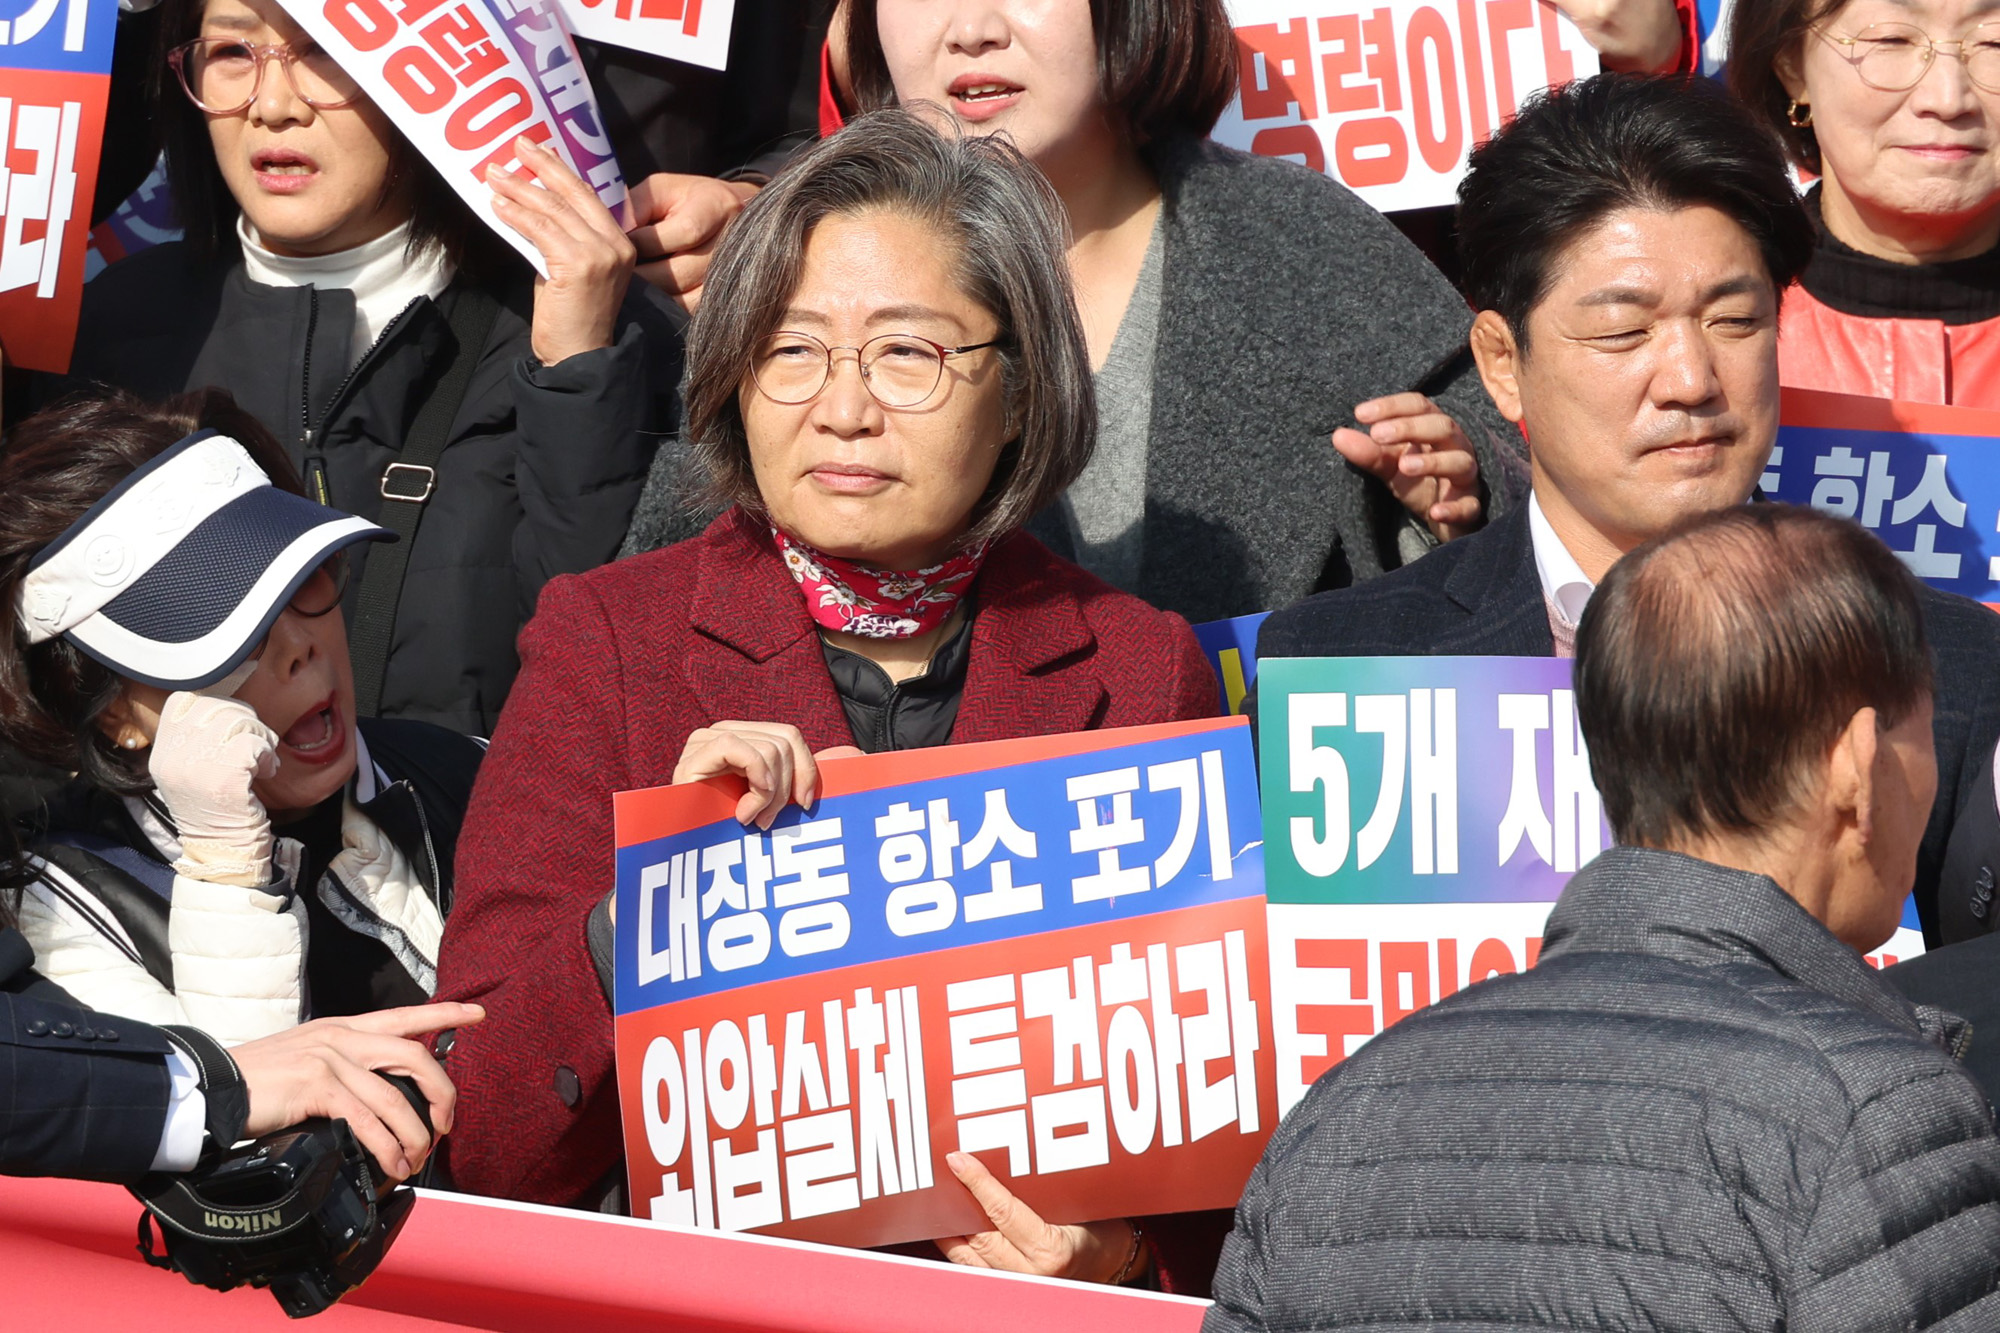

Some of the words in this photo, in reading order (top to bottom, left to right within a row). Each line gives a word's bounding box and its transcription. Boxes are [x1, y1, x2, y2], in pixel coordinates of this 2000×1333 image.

[639, 816, 852, 987] 대장동
[875, 788, 1044, 937] 항소
[1065, 749, 1234, 904] 포기
[1287, 687, 1460, 878] 5개
[641, 985, 934, 1233] 외압실체
[946, 929, 1260, 1177] 특검하라
[204, 1209, 283, 1234] Nikon
